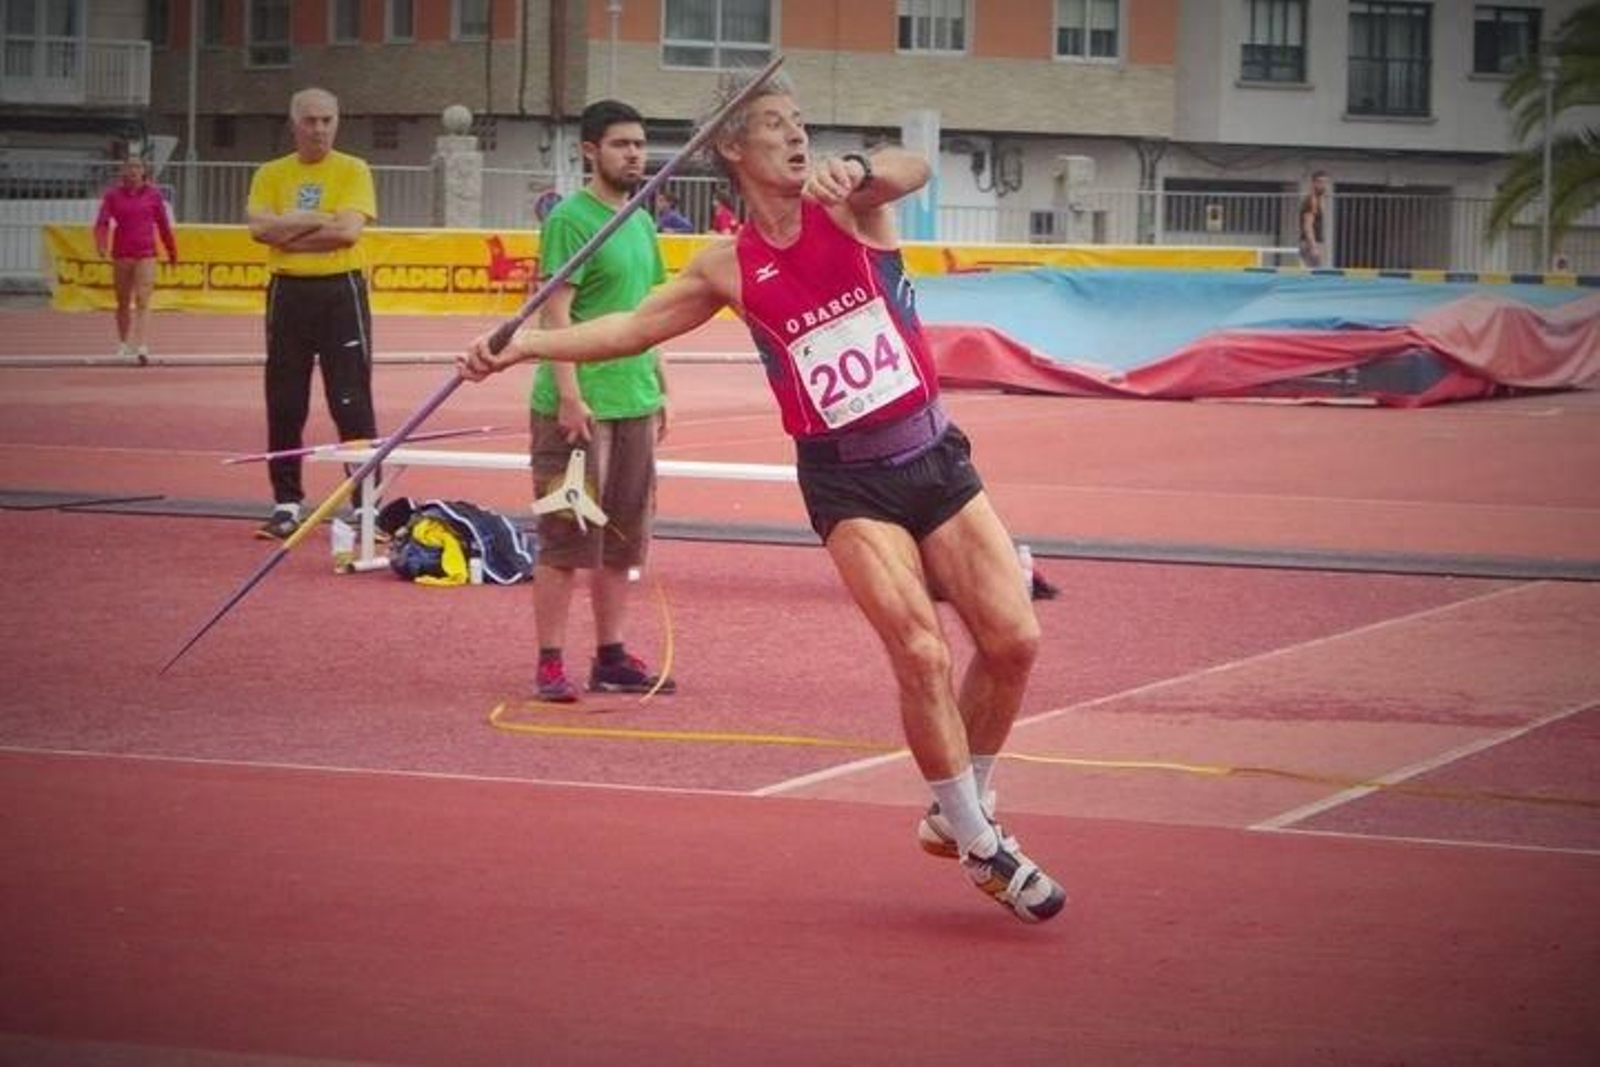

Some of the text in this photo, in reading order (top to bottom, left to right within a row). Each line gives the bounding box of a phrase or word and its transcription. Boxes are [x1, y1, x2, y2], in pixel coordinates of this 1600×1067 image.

[373, 267, 448, 290] GADIS
[786, 319, 800, 334] O
[803, 287, 868, 327] BARCO
[809, 333, 901, 410] 204
